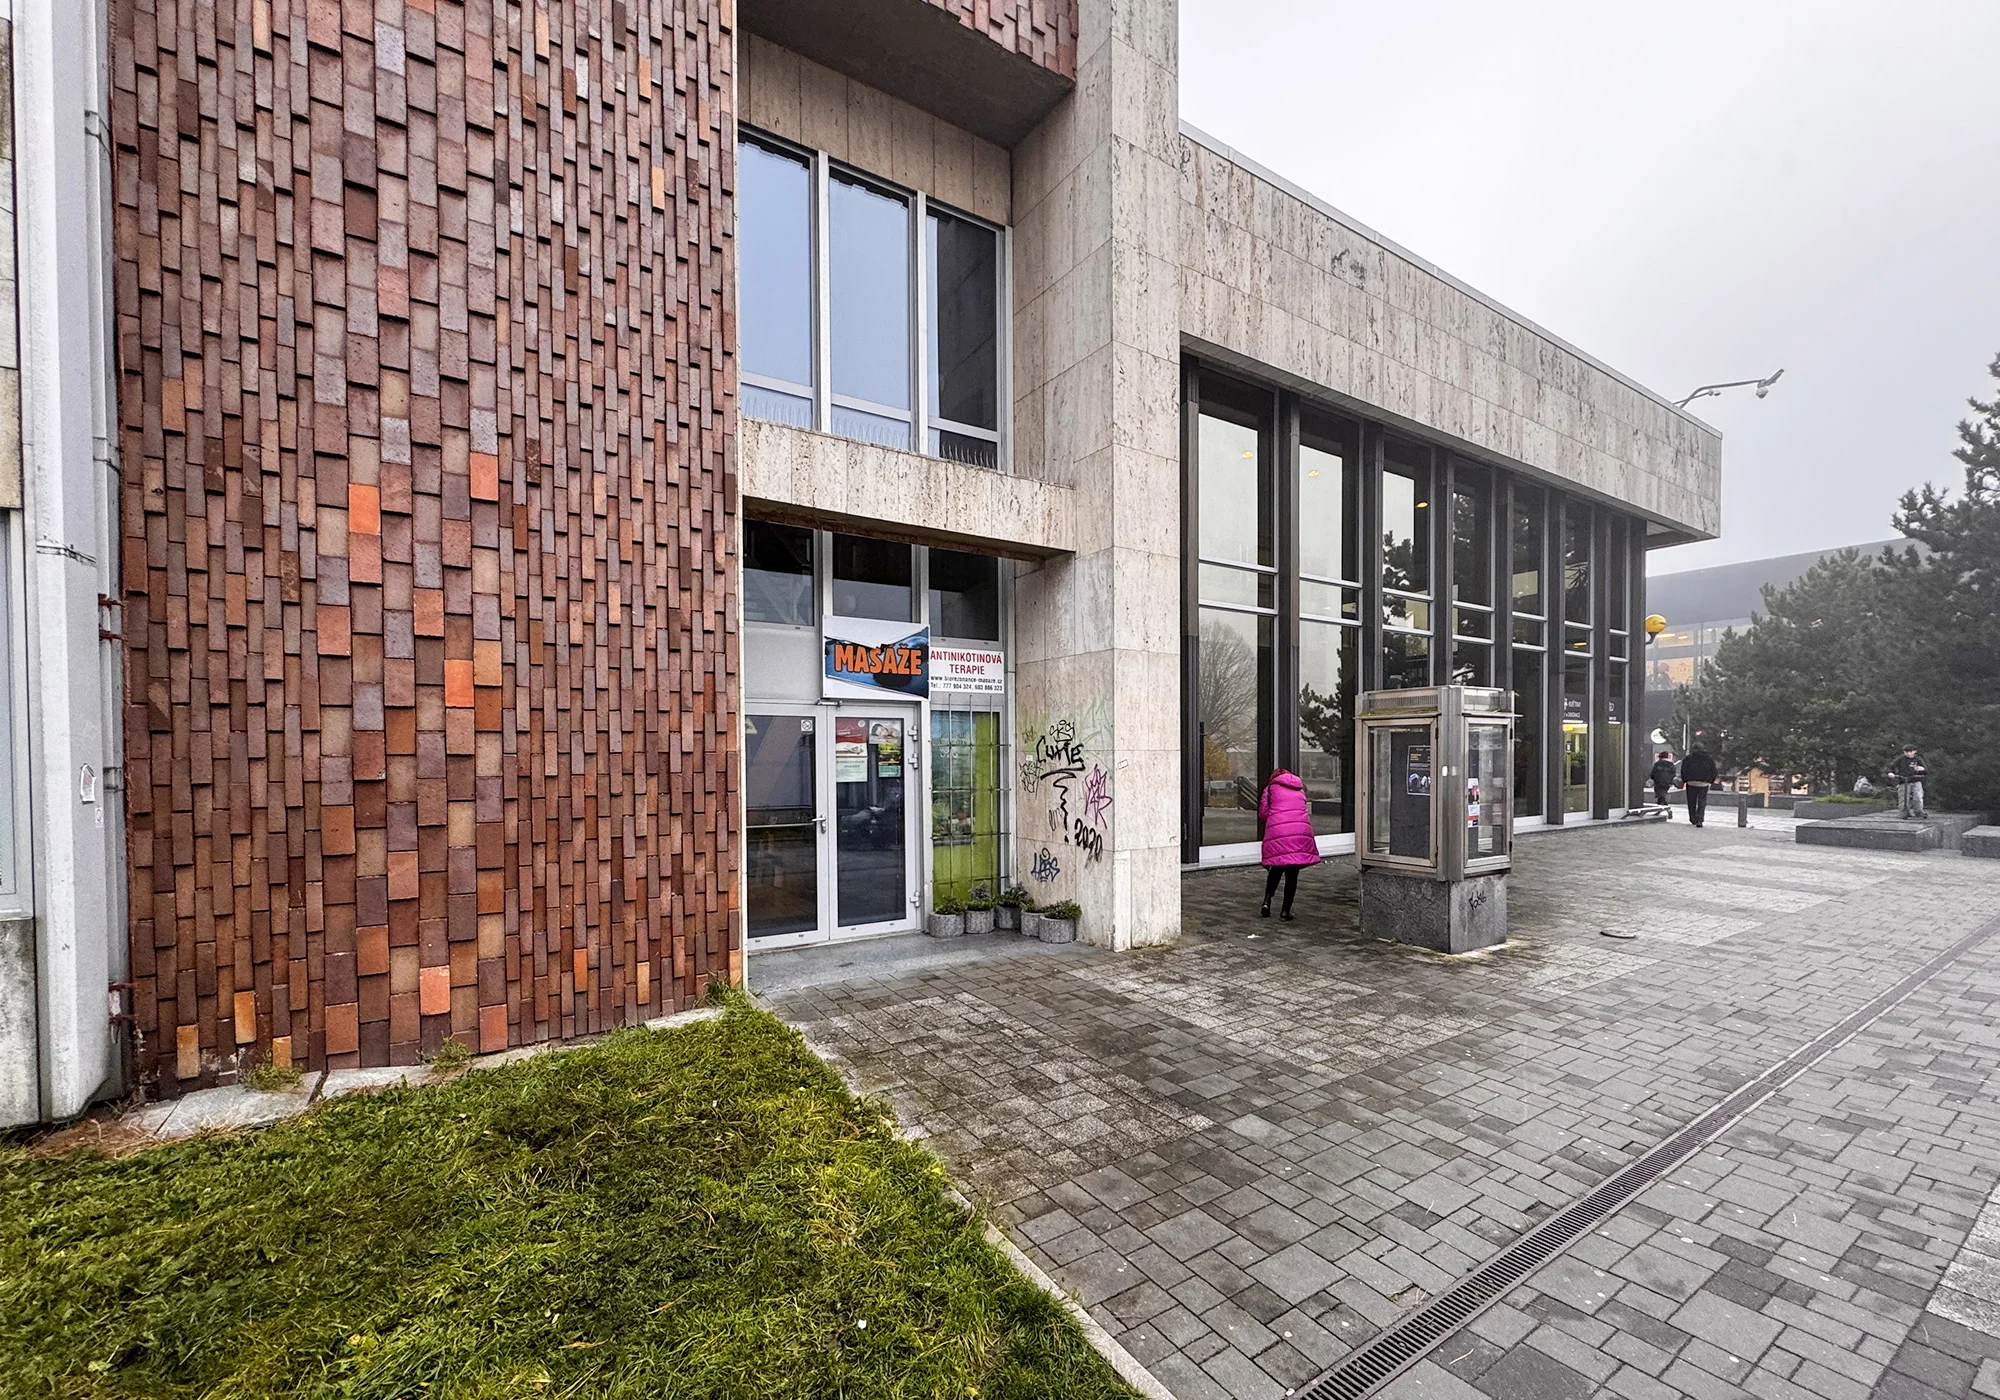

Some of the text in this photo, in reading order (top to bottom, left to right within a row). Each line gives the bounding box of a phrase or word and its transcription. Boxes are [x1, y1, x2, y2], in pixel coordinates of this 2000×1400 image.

[834, 643, 922, 675] MASÁŽE
[930, 650, 1002, 664] ANTINIKOTINOVÁ
[949, 664, 985, 675] TERAPIE
